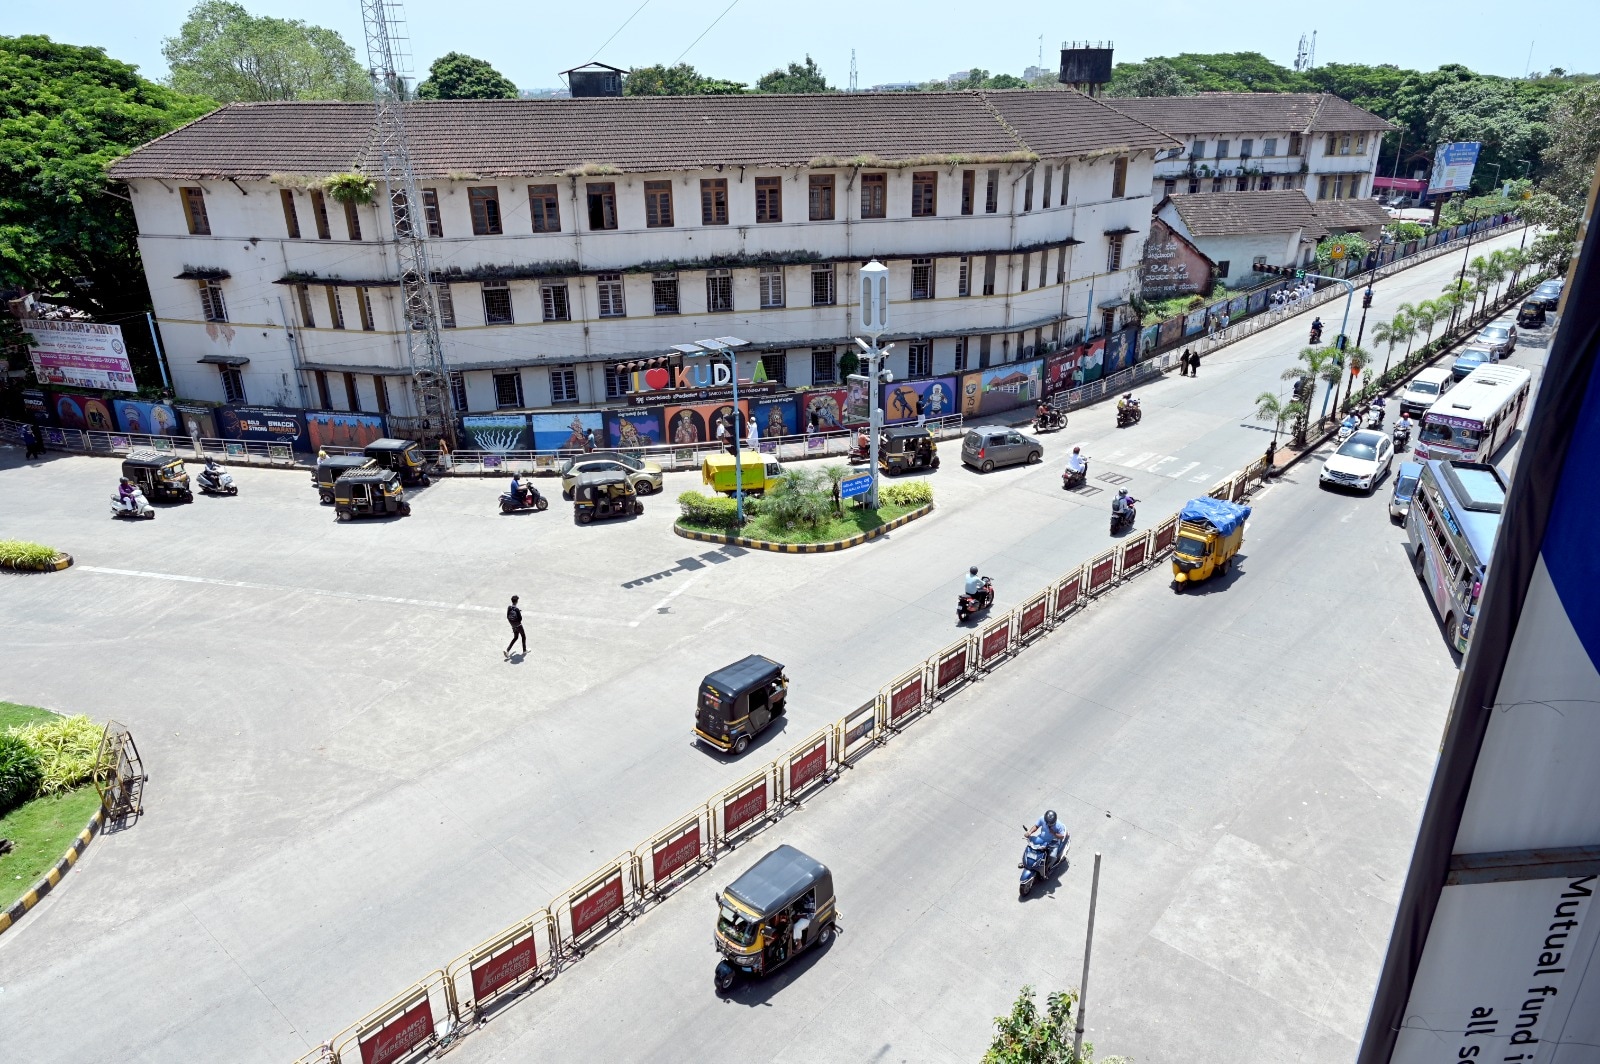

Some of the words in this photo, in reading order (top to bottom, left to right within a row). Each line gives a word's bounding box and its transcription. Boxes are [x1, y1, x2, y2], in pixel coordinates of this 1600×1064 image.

[1533, 874, 1598, 977] Mutual
[486, 955, 531, 986] SUPERCRETE
[501, 949, 531, 970] RAMCO
[395, 1015, 427, 1040] RAMCO
[1464, 1006, 1499, 1037] all
[1509, 985, 1558, 1045] fund
[379, 1021, 428, 1060] SUPERCRETE
[403, 1030, 427, 1049] CEMENT
[1457, 1045, 1480, 1064] s
[1503, 1053, 1534, 1064] i
